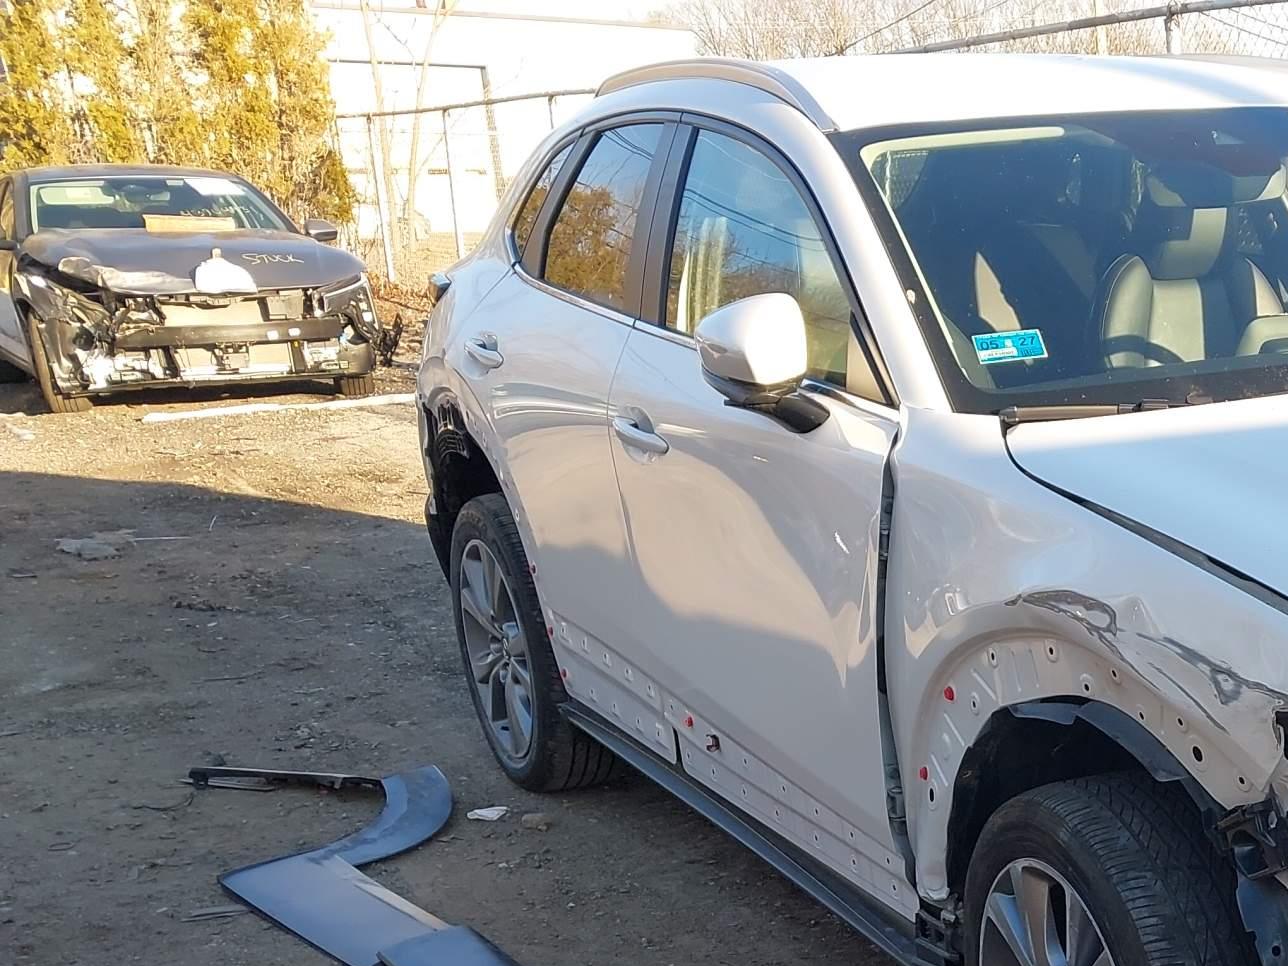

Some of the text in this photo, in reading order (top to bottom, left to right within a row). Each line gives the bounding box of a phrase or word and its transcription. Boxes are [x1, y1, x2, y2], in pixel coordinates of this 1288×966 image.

[241, 253, 305, 265] STUCK
[980, 340, 1000, 351] 05
[1018, 335, 1037, 346] 27
